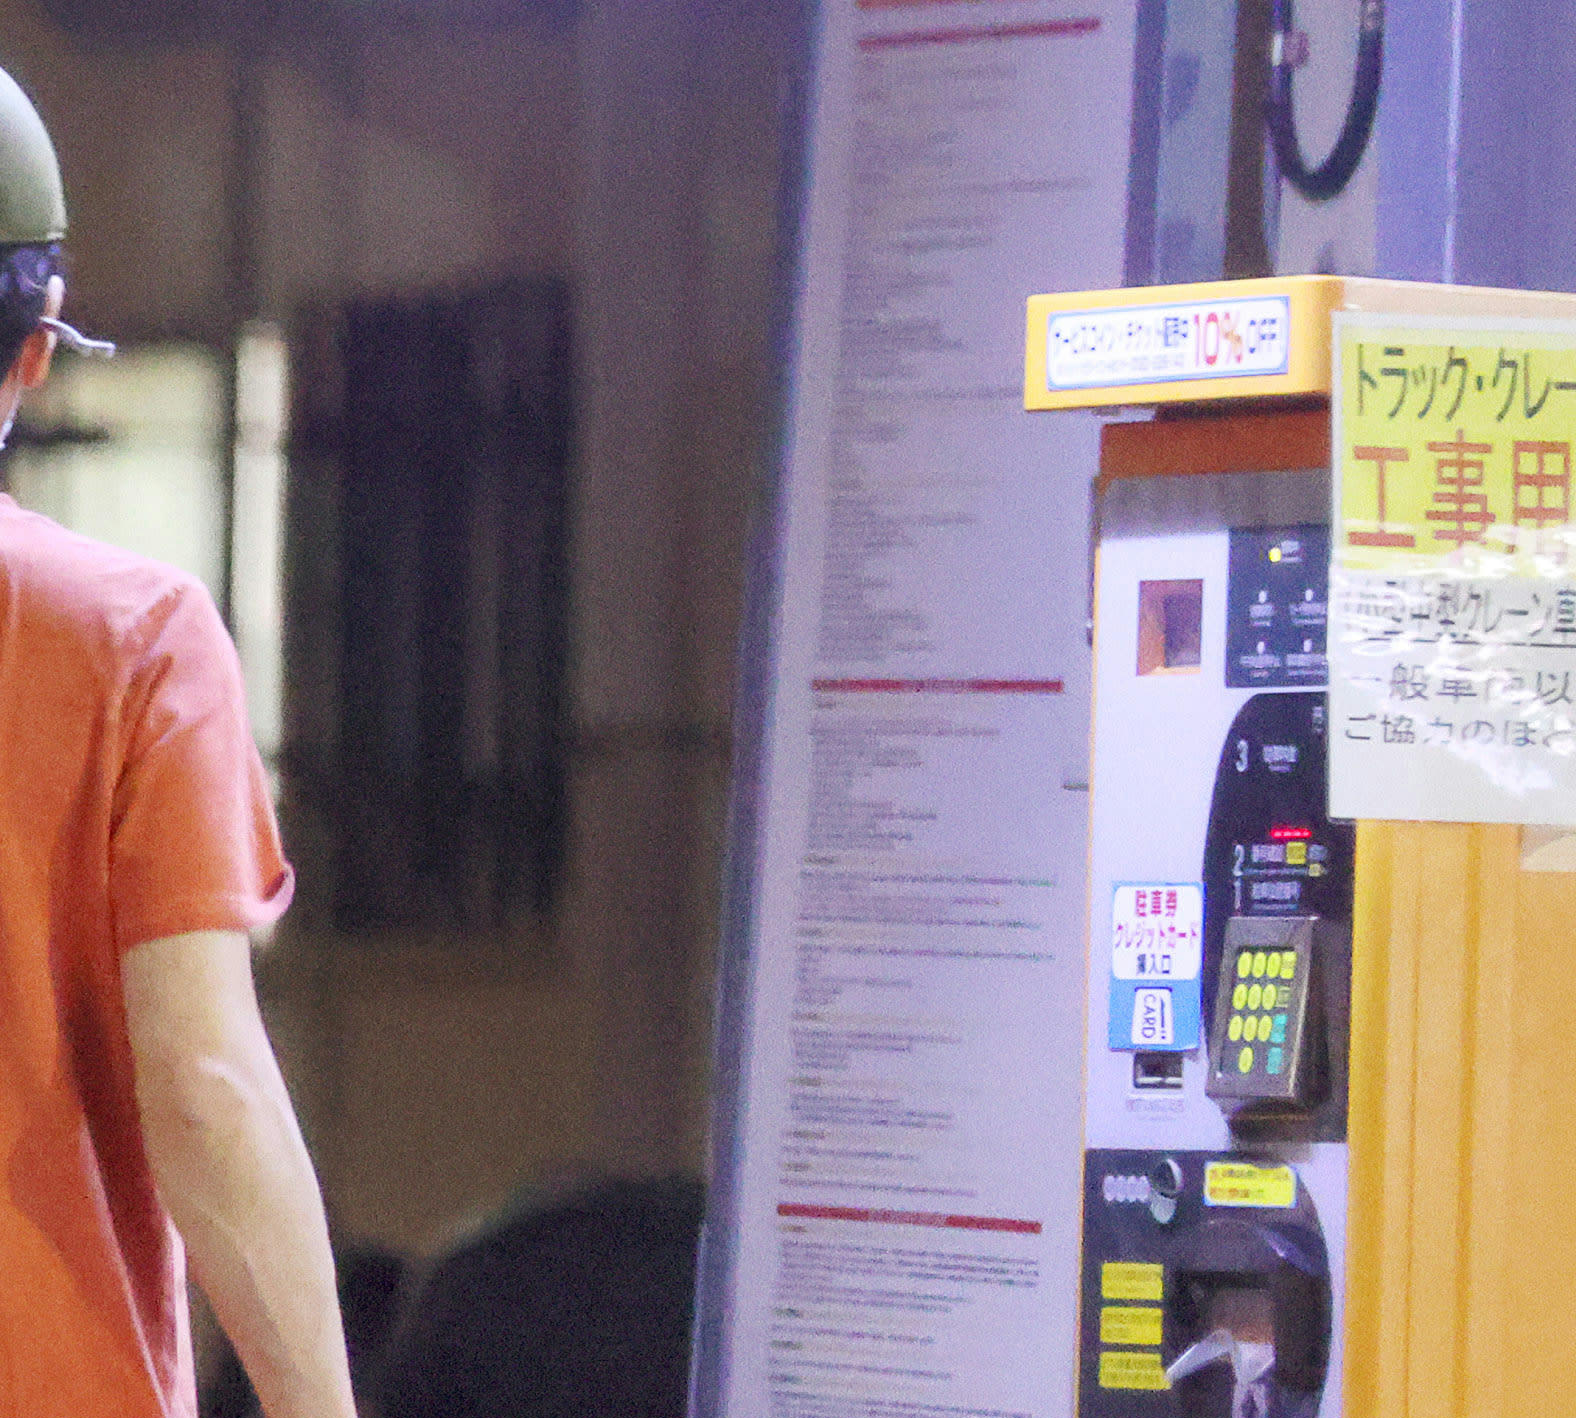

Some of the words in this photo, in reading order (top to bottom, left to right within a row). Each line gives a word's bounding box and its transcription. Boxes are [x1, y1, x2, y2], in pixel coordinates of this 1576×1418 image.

[1235, 739, 1249, 773] 3
[1234, 843, 1246, 877] 2
[1141, 993, 1157, 1040] CARD
